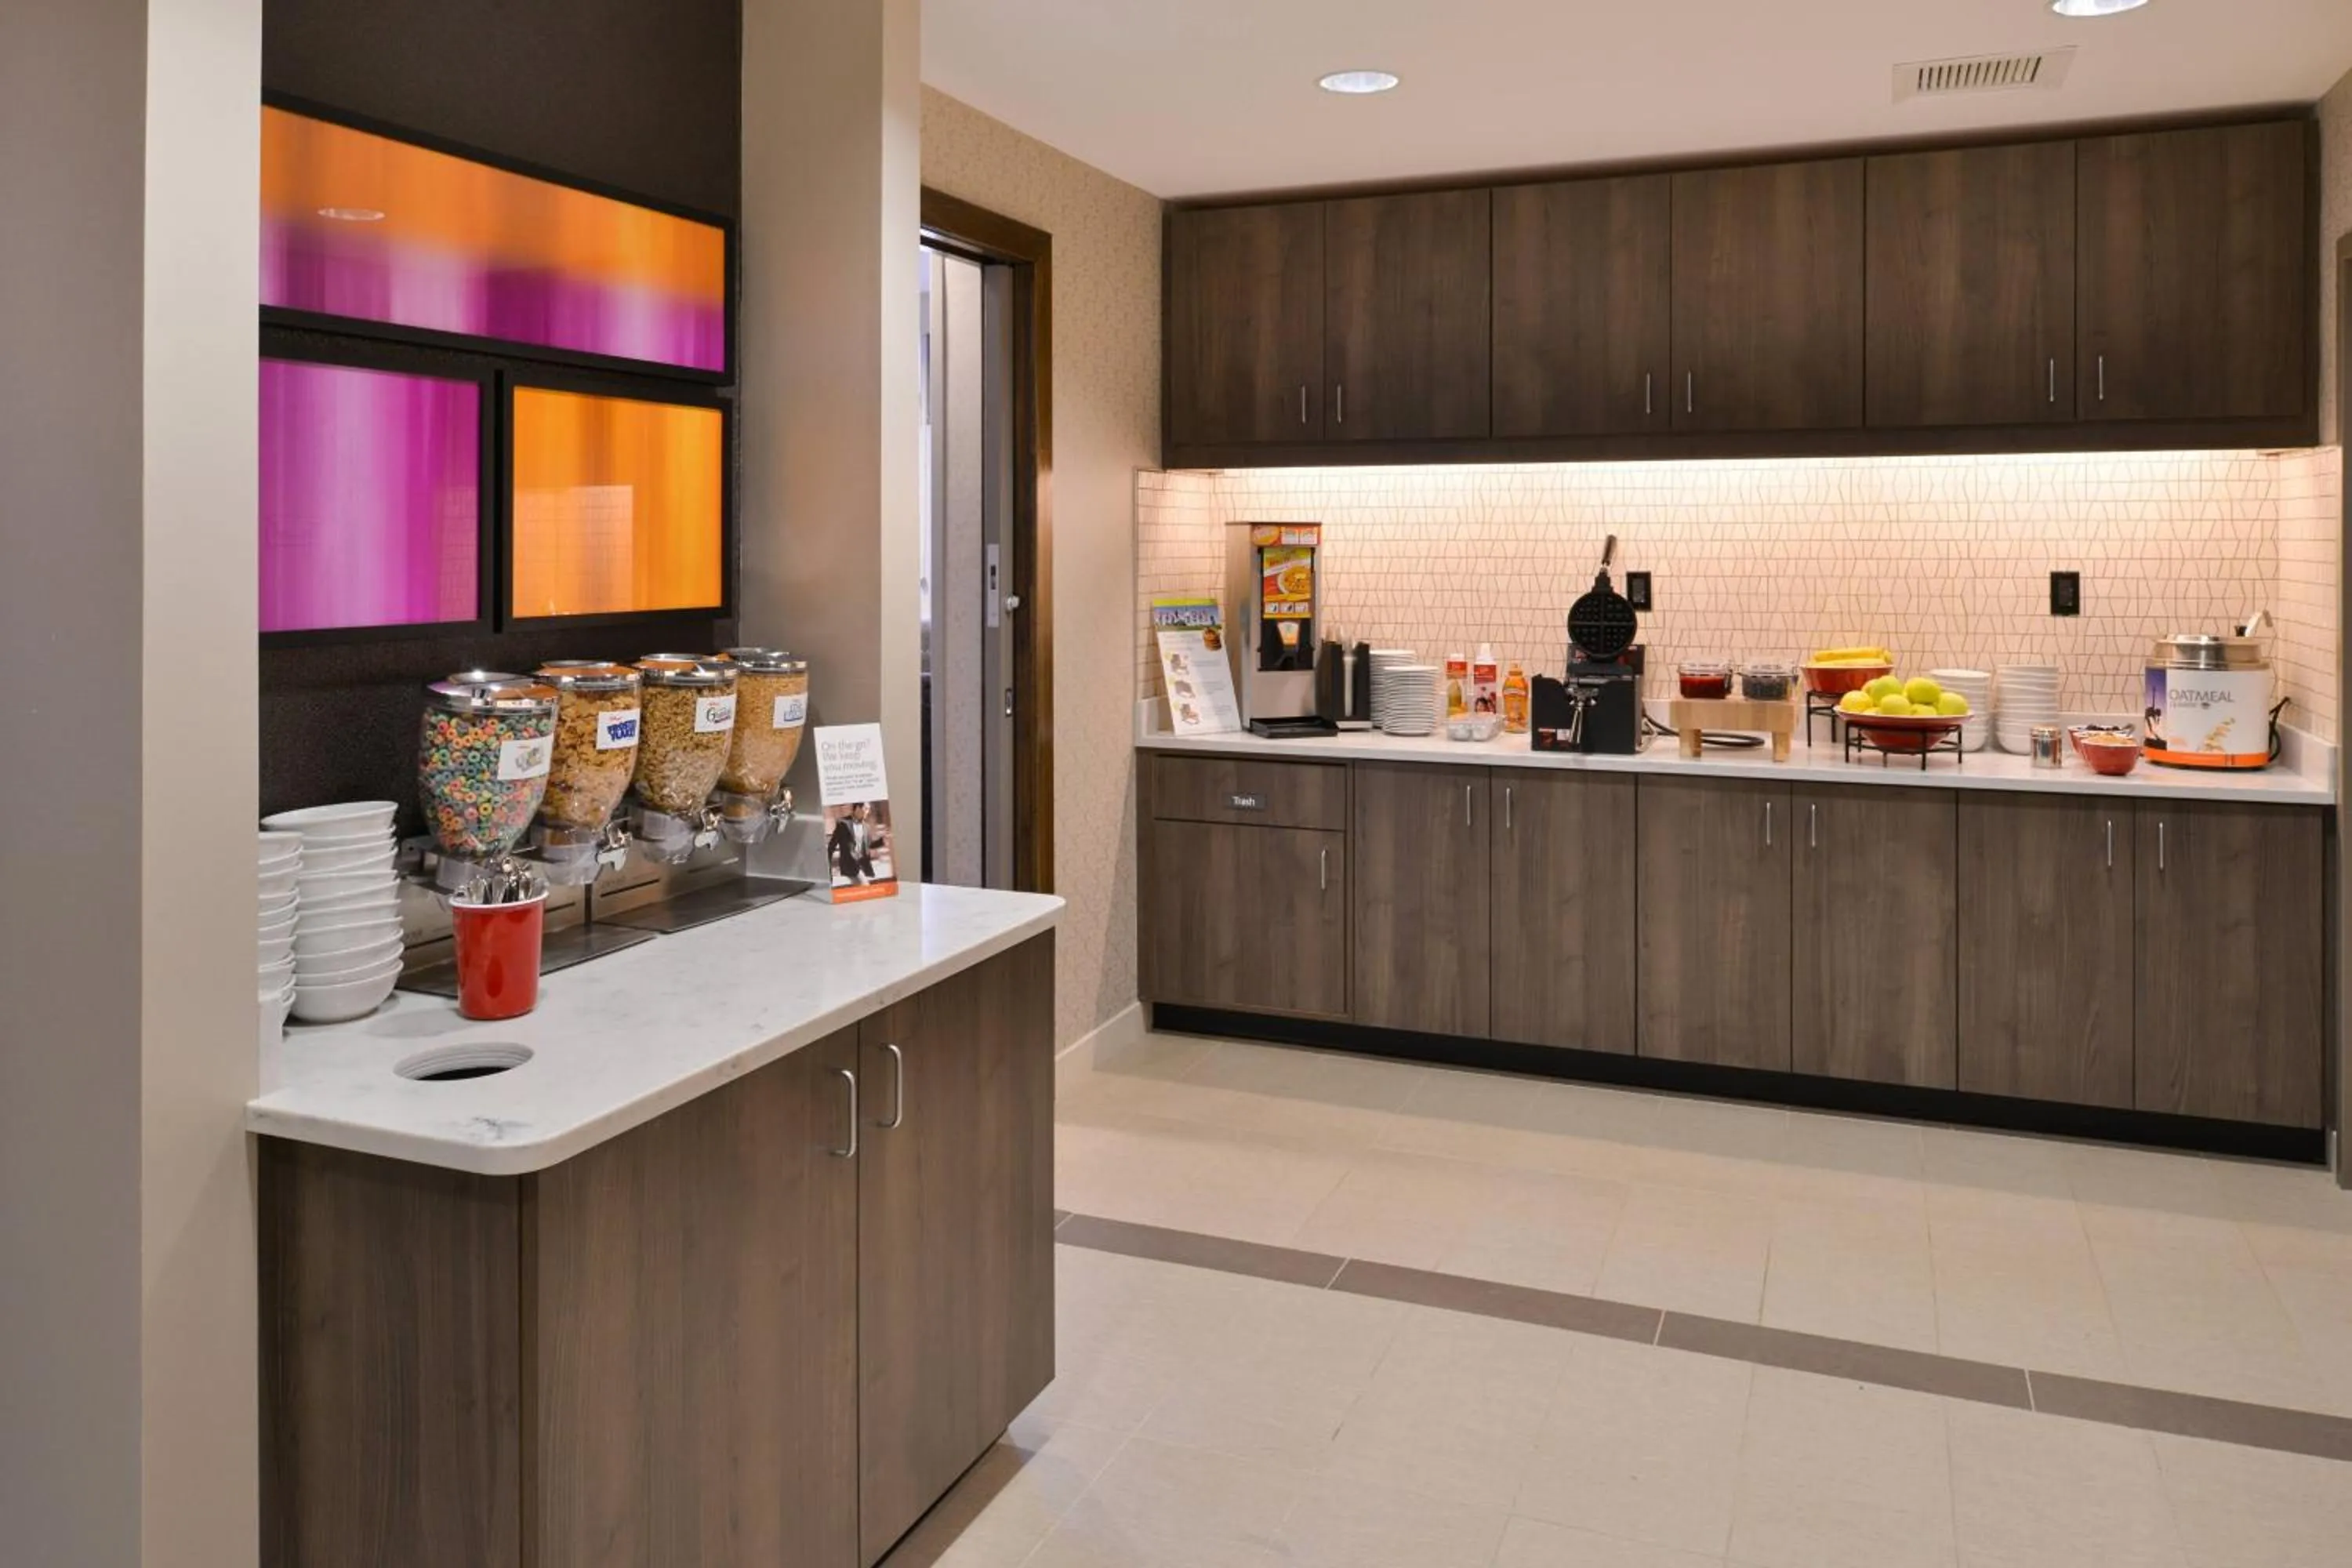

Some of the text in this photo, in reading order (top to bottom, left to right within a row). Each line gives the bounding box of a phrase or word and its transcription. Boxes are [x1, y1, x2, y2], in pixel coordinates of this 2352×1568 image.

[2169, 689, 2235, 703] OATMEAL
[821, 741, 836, 751] On
[1232, 796, 1255, 807] Trash
